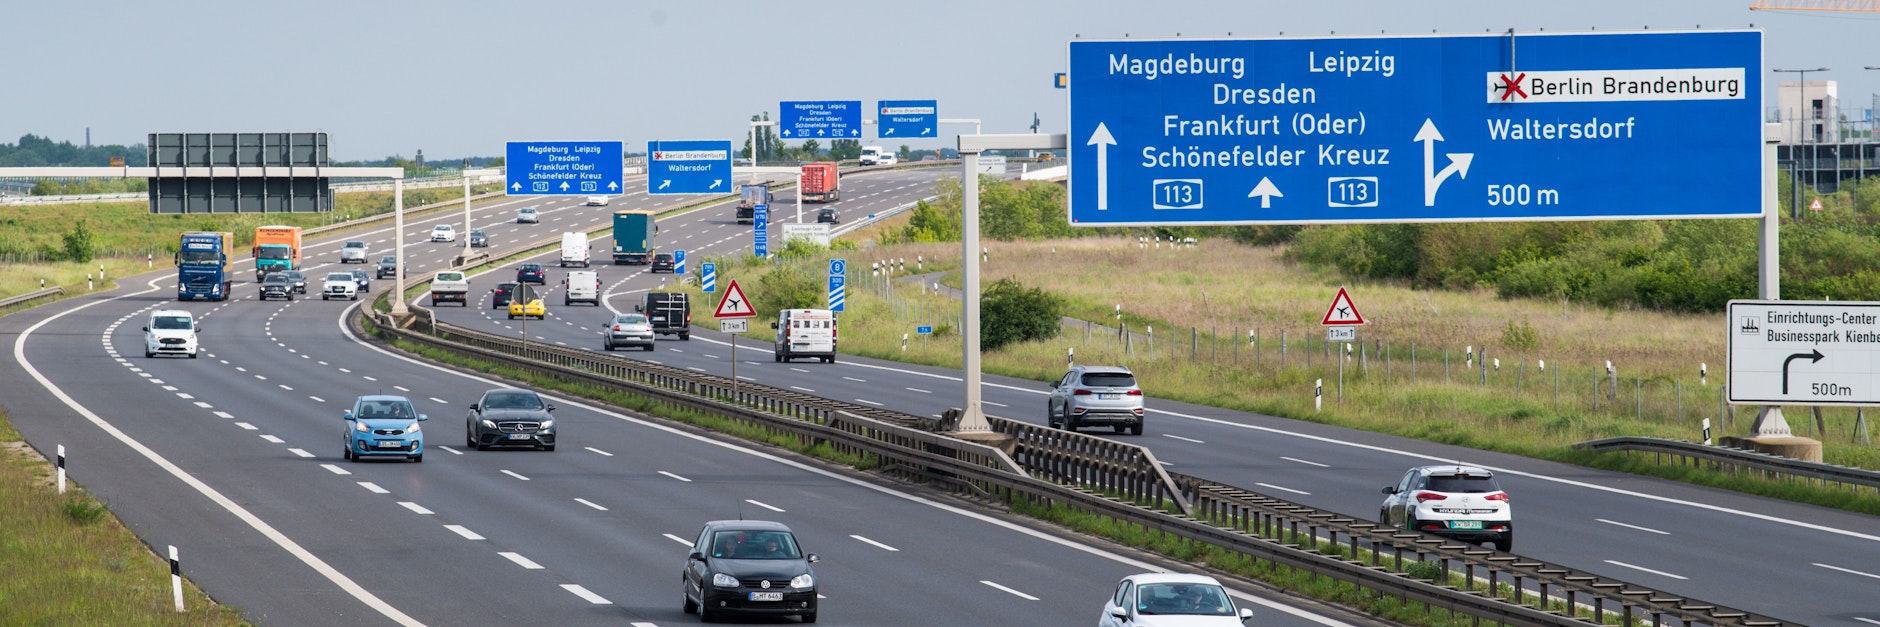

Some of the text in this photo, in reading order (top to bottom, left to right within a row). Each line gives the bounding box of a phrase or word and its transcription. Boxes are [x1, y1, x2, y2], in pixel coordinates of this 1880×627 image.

[1109, 51, 1396, 79] Magdeburg Leipzig
[1213, 83, 1317, 105] Dresden
[1530, 74, 1740, 98] Berlin Brandenburg
[1163, 112, 1367, 137] Frankfurt (Oder)
[1487, 117, 1636, 140] Waltersdorf
[527, 146, 601, 154] Magdeburg Leipzig
[685, 151, 726, 160] Brandenburg
[1141, 144, 1391, 168] Schönefelder Kreuz
[528, 172, 602, 180] Schönefelder Kreuz
[534, 163, 595, 172] Frankfurt (Oder)
[668, 163, 712, 172] Waltersdorf
[1162, 184, 1193, 204] 113
[1337, 182, 1369, 202] 113
[1487, 184, 1560, 206] 500 m
[834, 263, 840, 272] 8
[1767, 310, 1877, 327] Einrichtungs-Center
[1335, 329, 1339, 337] 3
[1767, 329, 1840, 345] Businesspark
[1811, 383, 1852, 396] 500m
